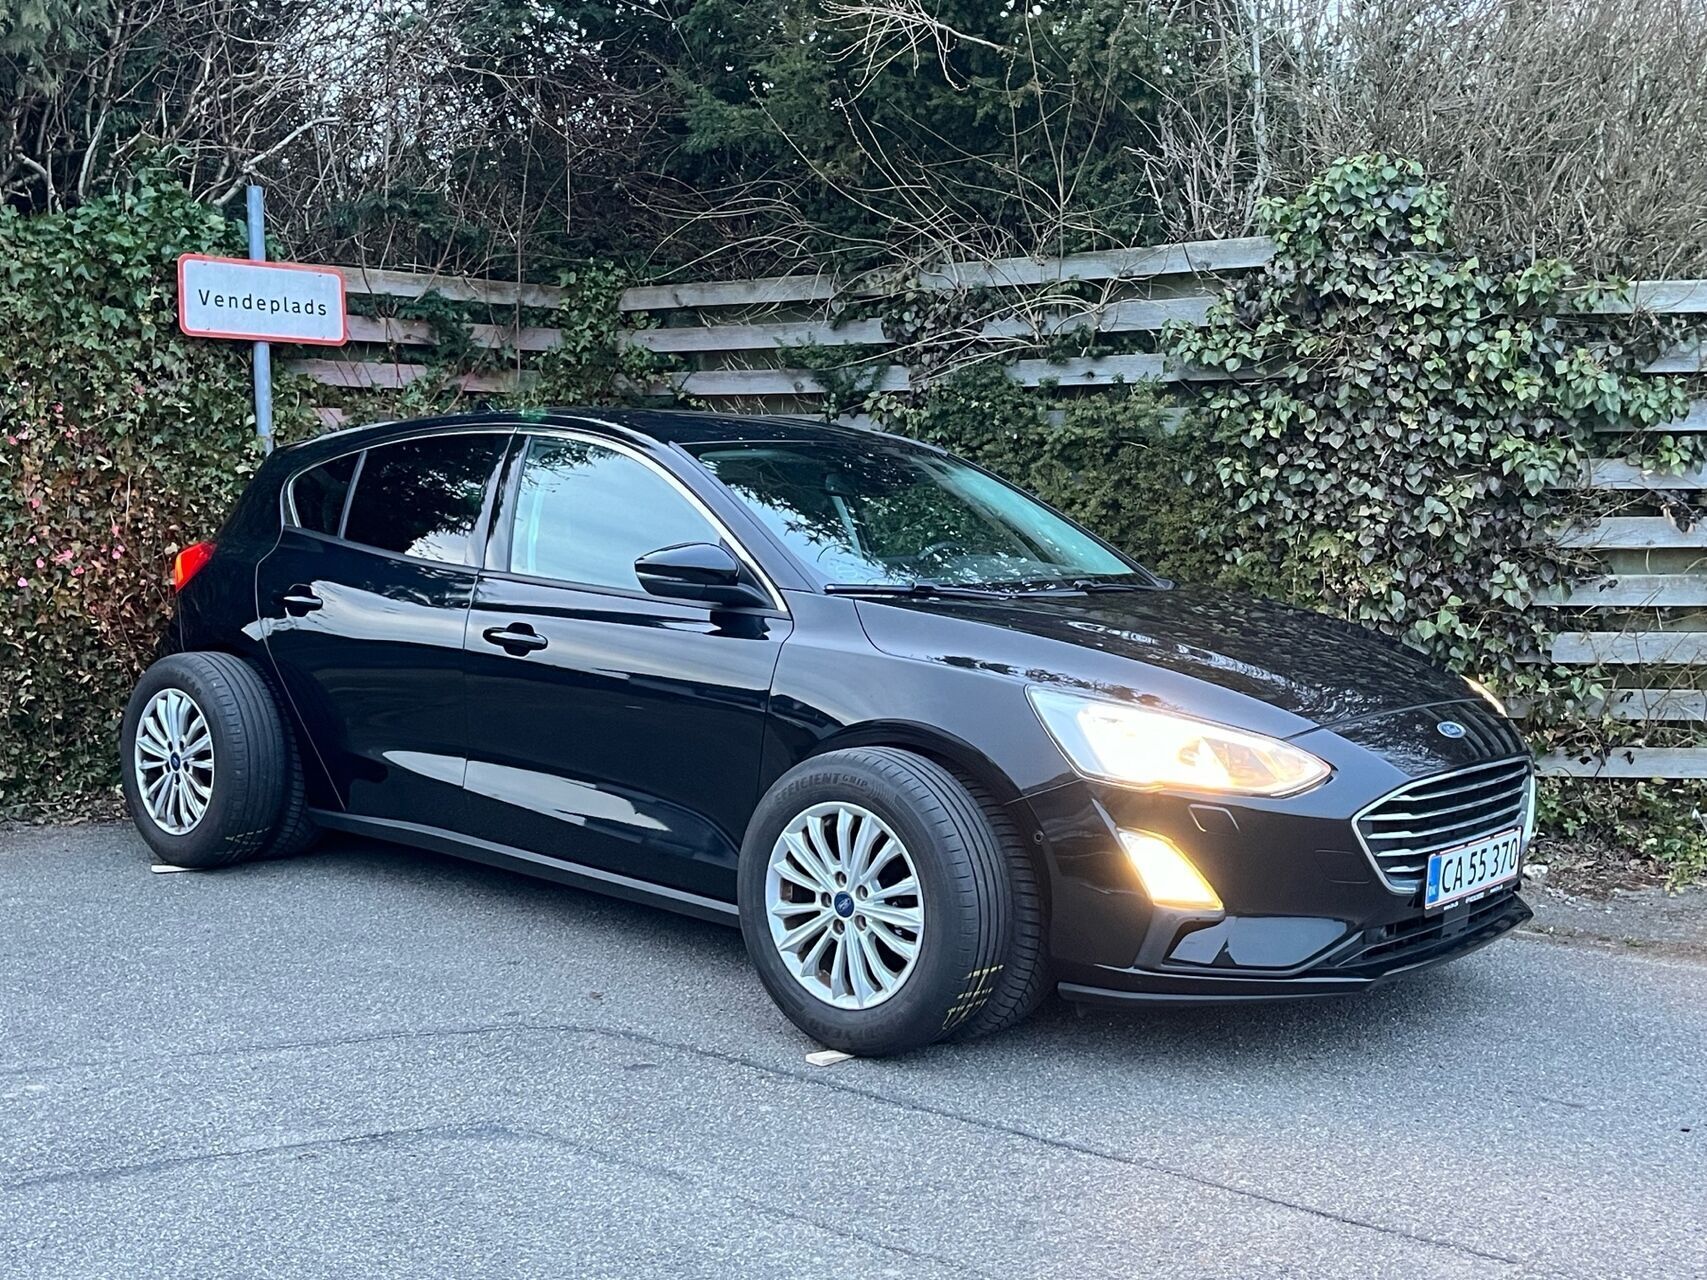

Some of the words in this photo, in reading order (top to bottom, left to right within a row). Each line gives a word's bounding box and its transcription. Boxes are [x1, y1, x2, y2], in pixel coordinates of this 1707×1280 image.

[198, 289, 327, 316] Vendeplads
[1442, 856, 1463, 893] CA
[1467, 848, 1487, 885] 55
[1490, 838, 1517, 877] 370
